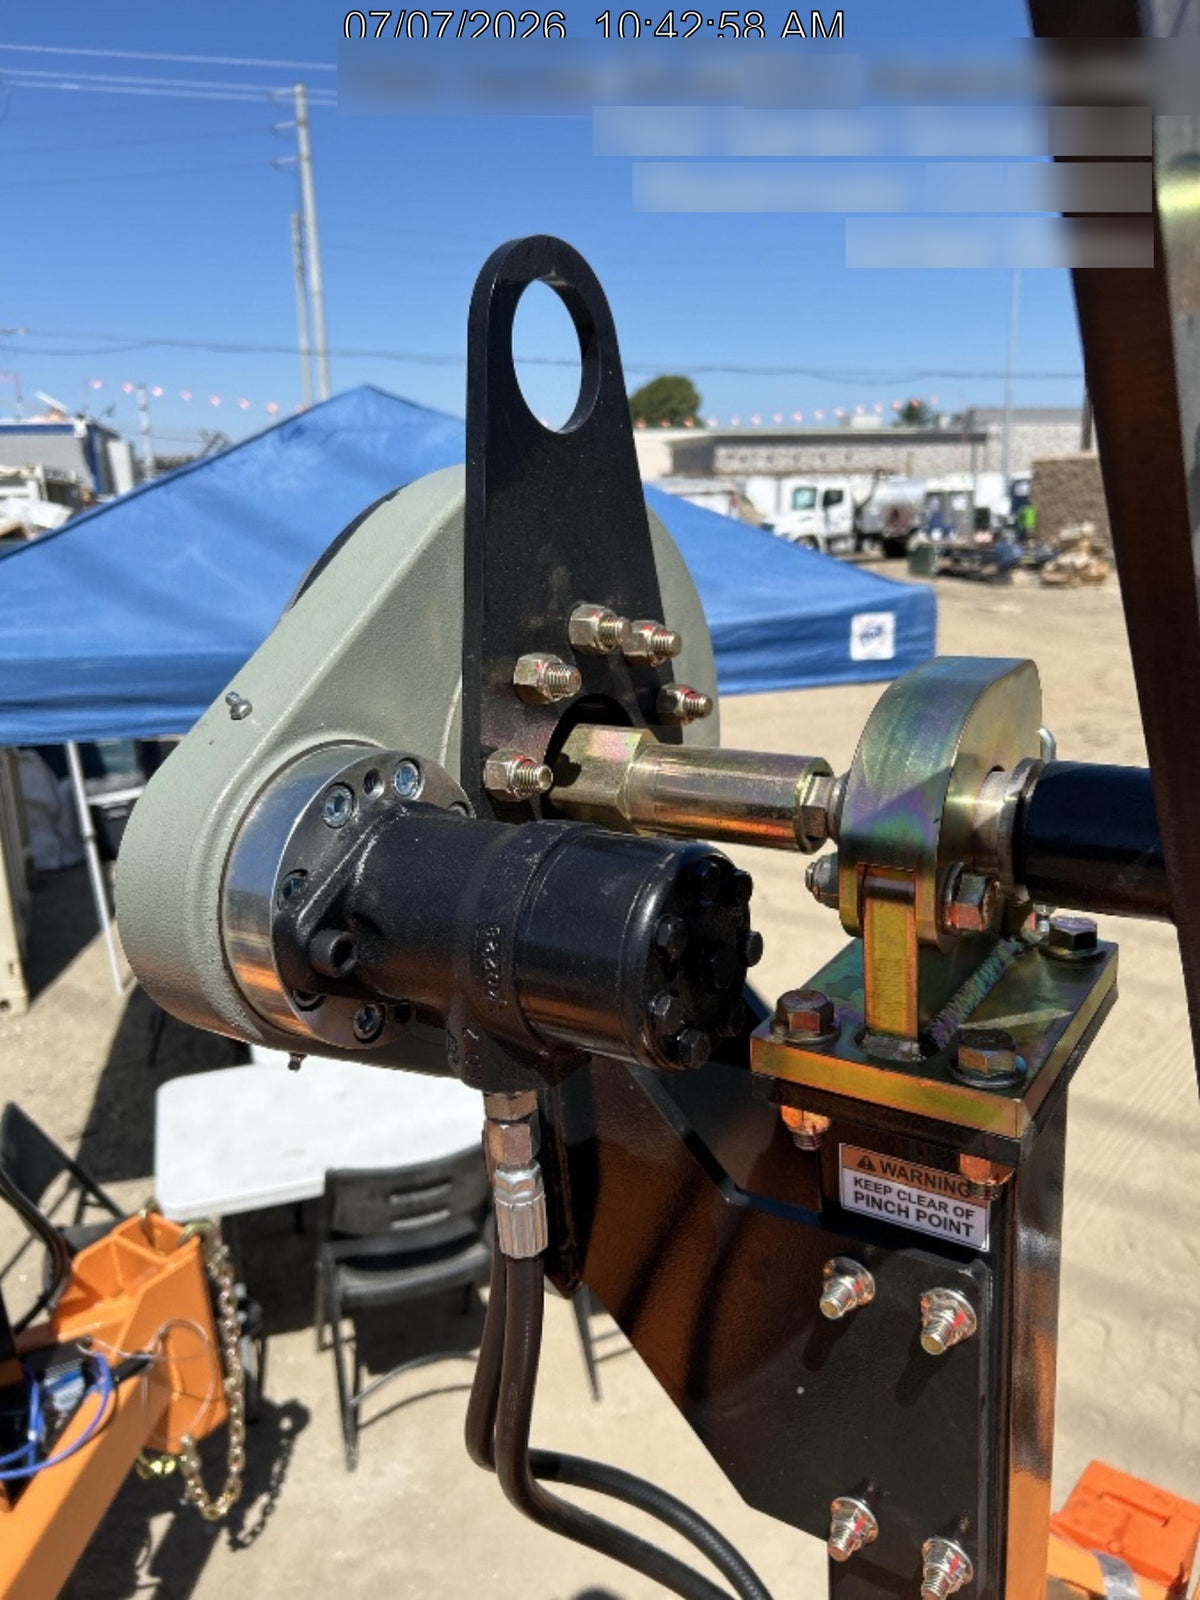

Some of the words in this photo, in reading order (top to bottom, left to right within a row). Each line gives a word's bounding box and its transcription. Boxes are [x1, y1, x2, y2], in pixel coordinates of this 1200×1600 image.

[853, 1176, 892, 1196] KEEP
[897, 1187, 949, 1214] CLEAR
[952, 1206, 975, 1221] OF
[879, 1160, 973, 1198] WARNING
[854, 1191, 910, 1219] PINCH
[915, 1209, 974, 1238] POINT
